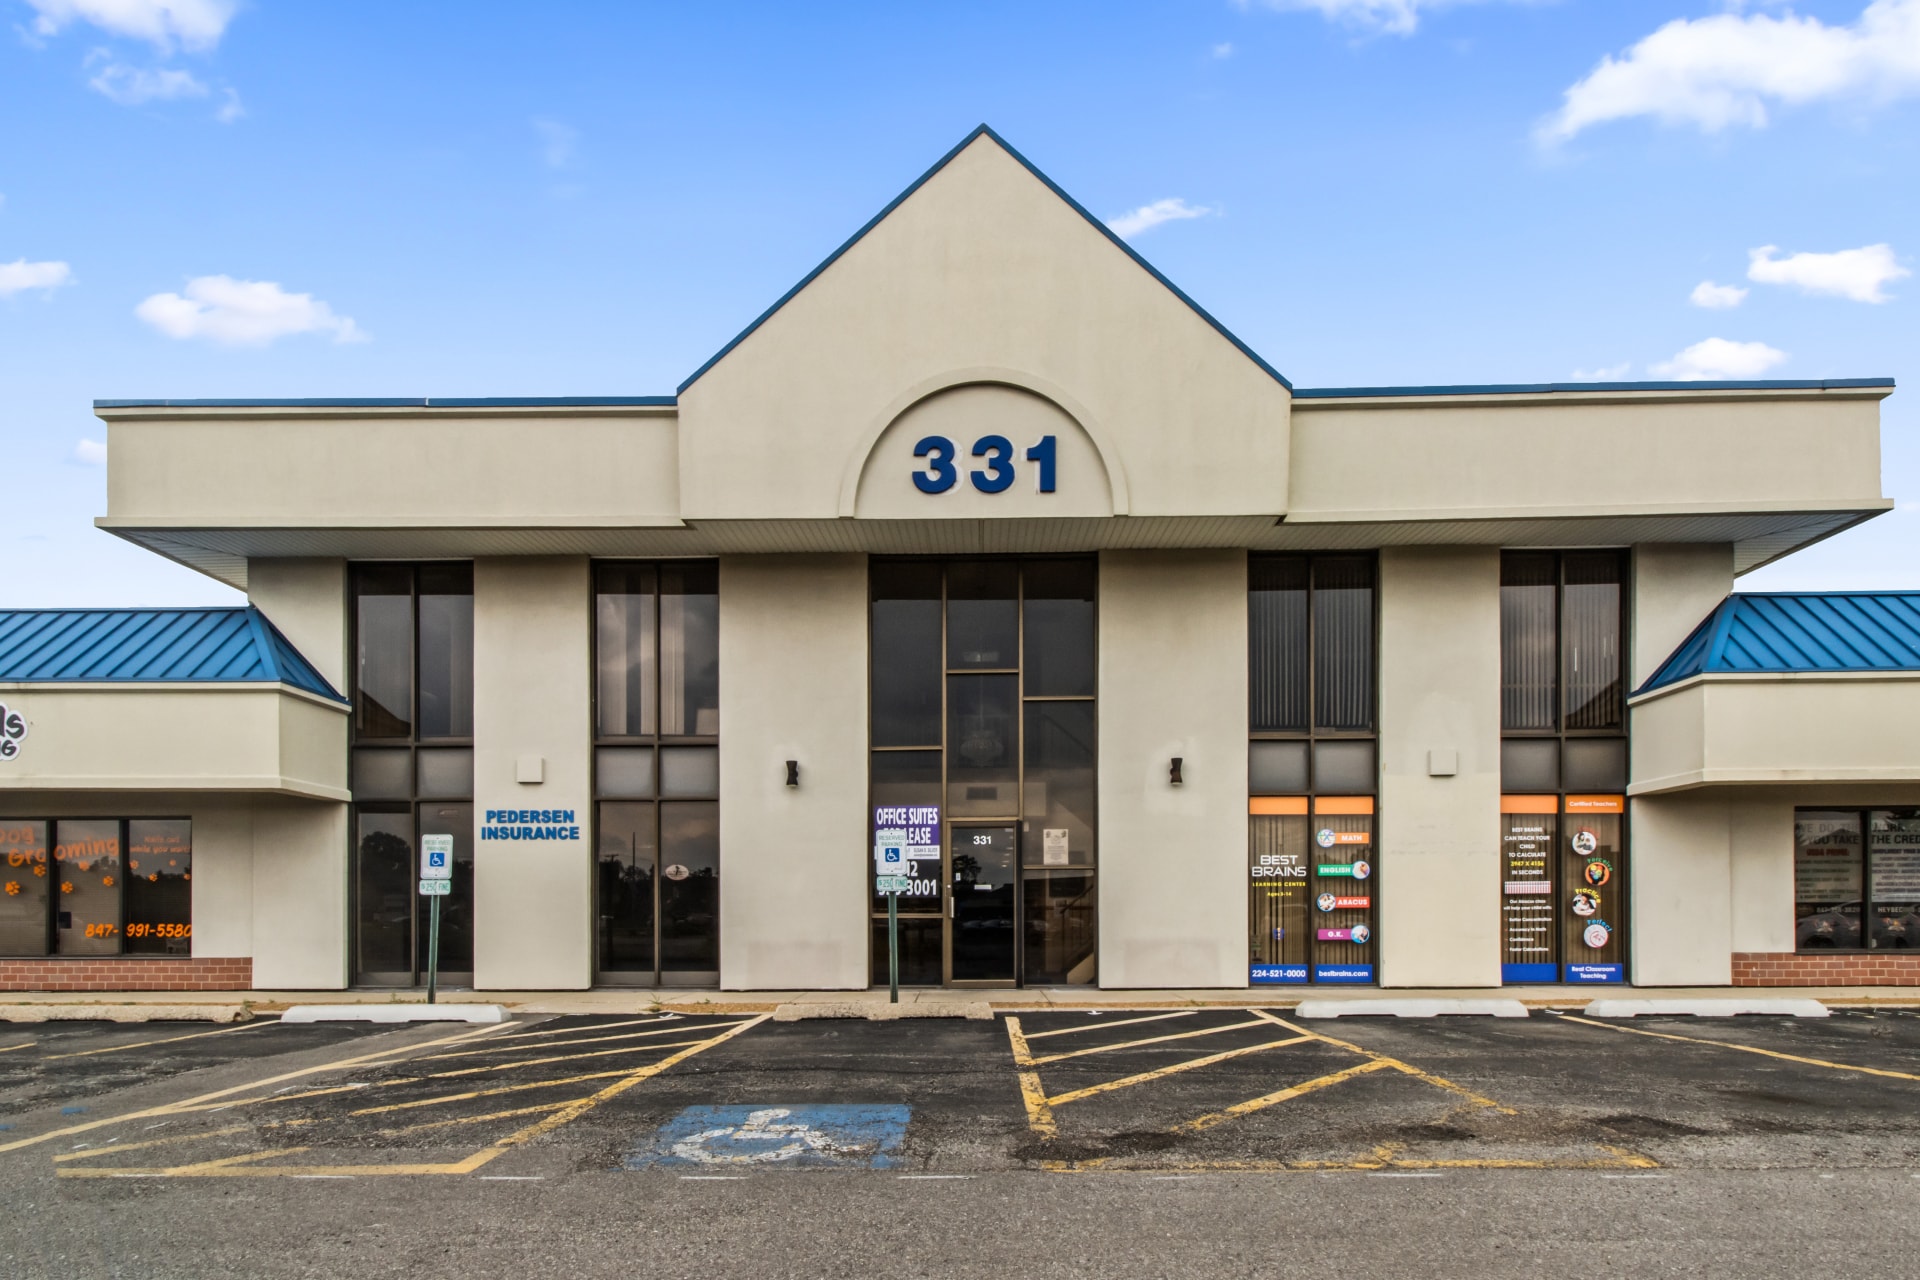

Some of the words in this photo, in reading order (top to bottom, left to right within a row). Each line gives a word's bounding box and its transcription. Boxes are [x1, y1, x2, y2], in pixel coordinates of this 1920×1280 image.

[911, 434, 1057, 495] 331
[486, 809, 575, 824] PEDERSEN
[877, 807, 907, 825] OFFICE
[908, 807, 938, 825] SUITES
[481, 826, 580, 841] INSURANCE
[973, 835, 993, 846] 331
[1832, 835, 1860, 845] TAKE
[1872, 834, 1892, 844] THE
[1260, 855, 1299, 866] BEST
[1251, 866, 1307, 877] BRAINS
[1320, 866, 1351, 874] ENGLISH
[1251, 969, 1307, 978] 224-521-0000
[1318, 969, 1369, 978] bestbrains.com
